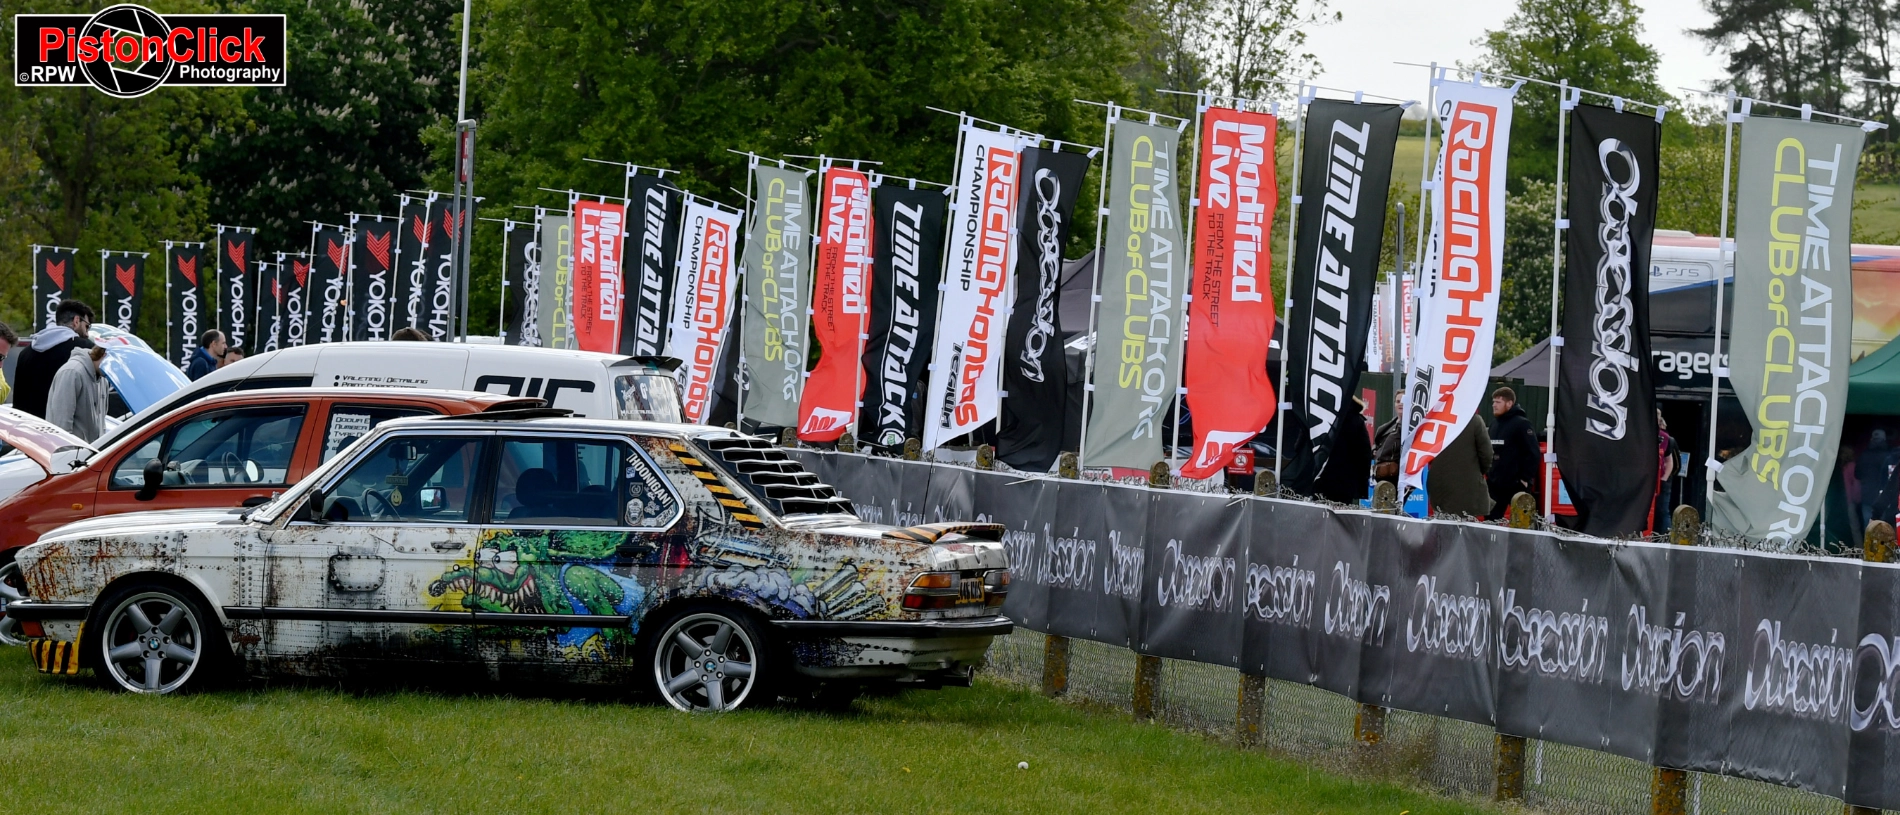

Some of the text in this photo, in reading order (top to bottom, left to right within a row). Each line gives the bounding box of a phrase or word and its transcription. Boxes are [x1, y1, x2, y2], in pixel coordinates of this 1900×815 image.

[827, 176, 855, 244] Live
[1207, 118, 1238, 209] Live
[1230, 121, 1266, 303] Modified
[581, 207, 600, 264] Live
[599, 210, 621, 321] Modified
[960, 144, 985, 292] CHAMPIONSHIP
[1202, 212, 1215, 300] TO THE TRACK
[683, 215, 703, 330] CHAMPIONSHIP
[1210, 213, 1224, 327] FROM THE STREET
[1666, 267, 1699, 278] PS5
